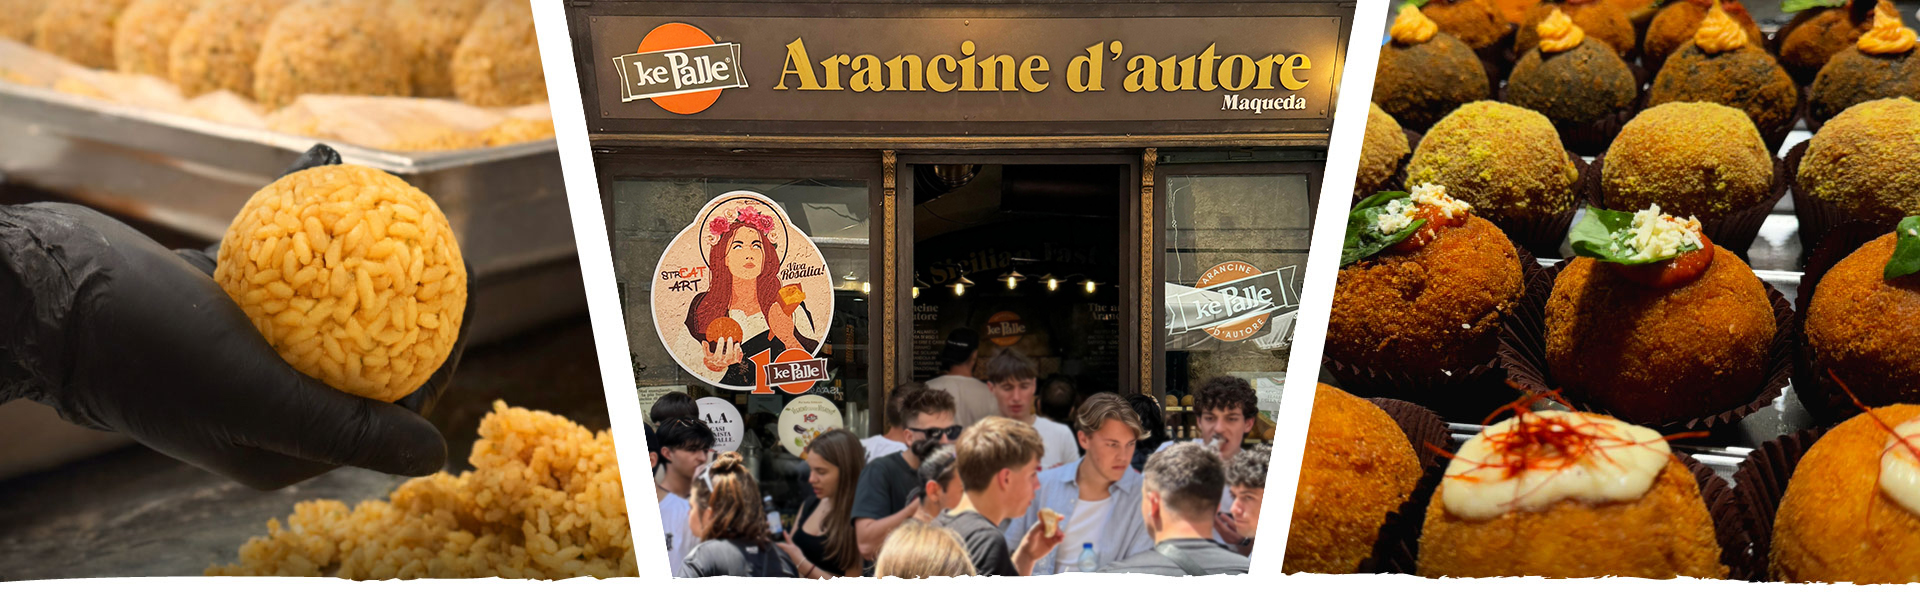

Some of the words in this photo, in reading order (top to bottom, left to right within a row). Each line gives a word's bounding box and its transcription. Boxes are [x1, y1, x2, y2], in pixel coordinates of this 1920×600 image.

[773, 37, 1050, 93] Arancine
[1066, 40, 1312, 93] d'autore
[1220, 94, 1307, 116] Maqueda
[780, 264, 826, 281] Rosalia!
[787, 262, 807, 274] Viva
[1201, 263, 1252, 285] ARANCINE
[668, 279, 702, 292] ART
[1213, 317, 1265, 339] D'AUTORE
